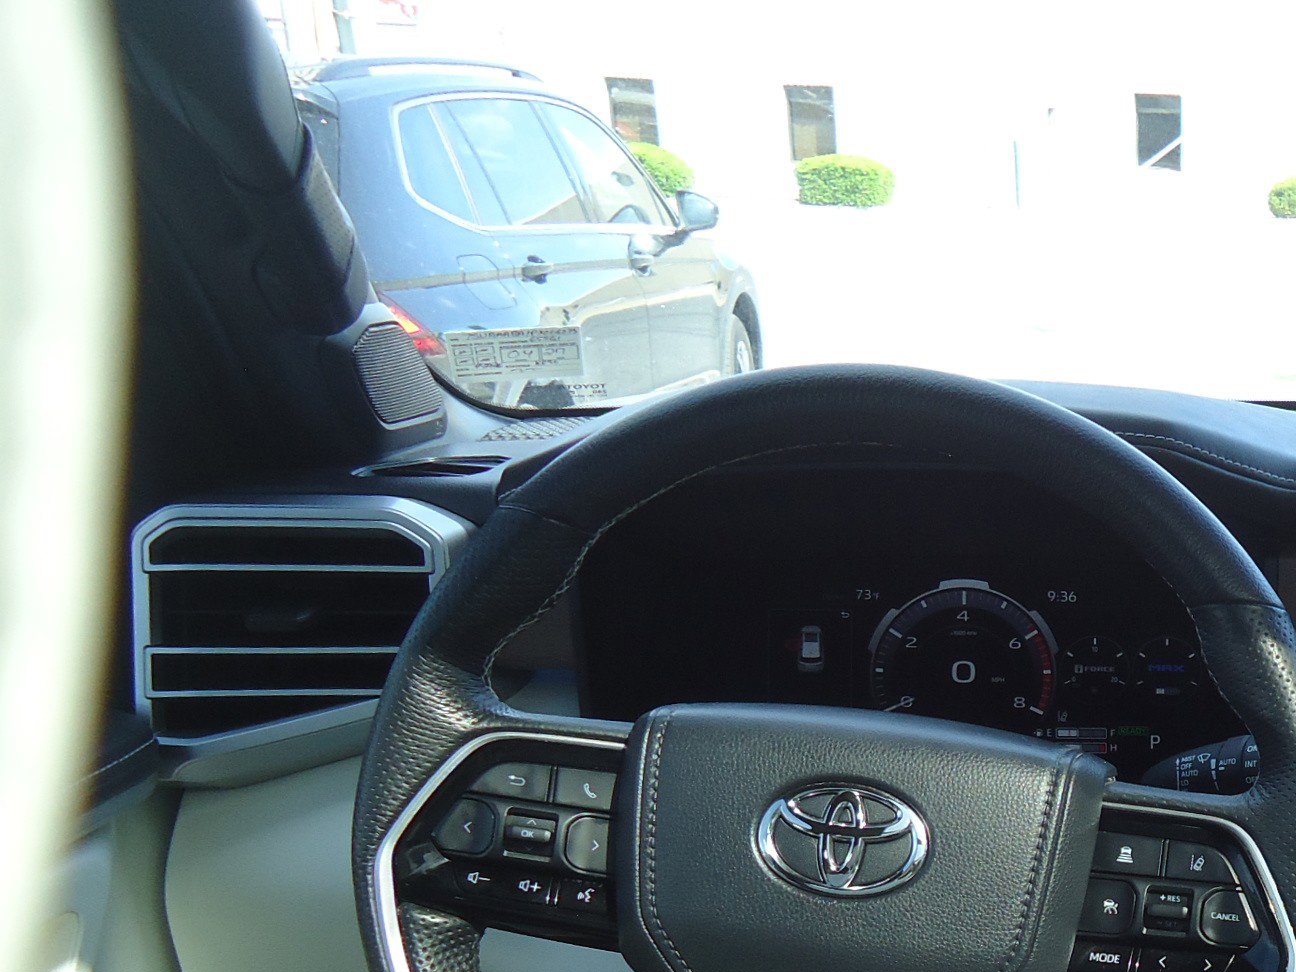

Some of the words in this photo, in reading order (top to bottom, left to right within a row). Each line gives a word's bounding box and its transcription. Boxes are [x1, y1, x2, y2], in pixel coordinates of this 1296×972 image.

[1047, 590, 1077, 603] 9:36
[956, 610, 970, 622] 4
[905, 637, 918, 649] 2
[1009, 637, 1022, 650] 6
[951, 660, 976, 684] 0
[1013, 697, 1026, 709] 8
[1149, 735, 1161, 749] P
[1219, 758, 1237, 766] AUTO
[1244, 760, 1258, 768] INT
[1181, 770, 1199, 778] AUTO
[521, 829, 534, 838] OK
[1211, 911, 1241, 922] CANCEL
[1089, 952, 1122, 965] MODE
